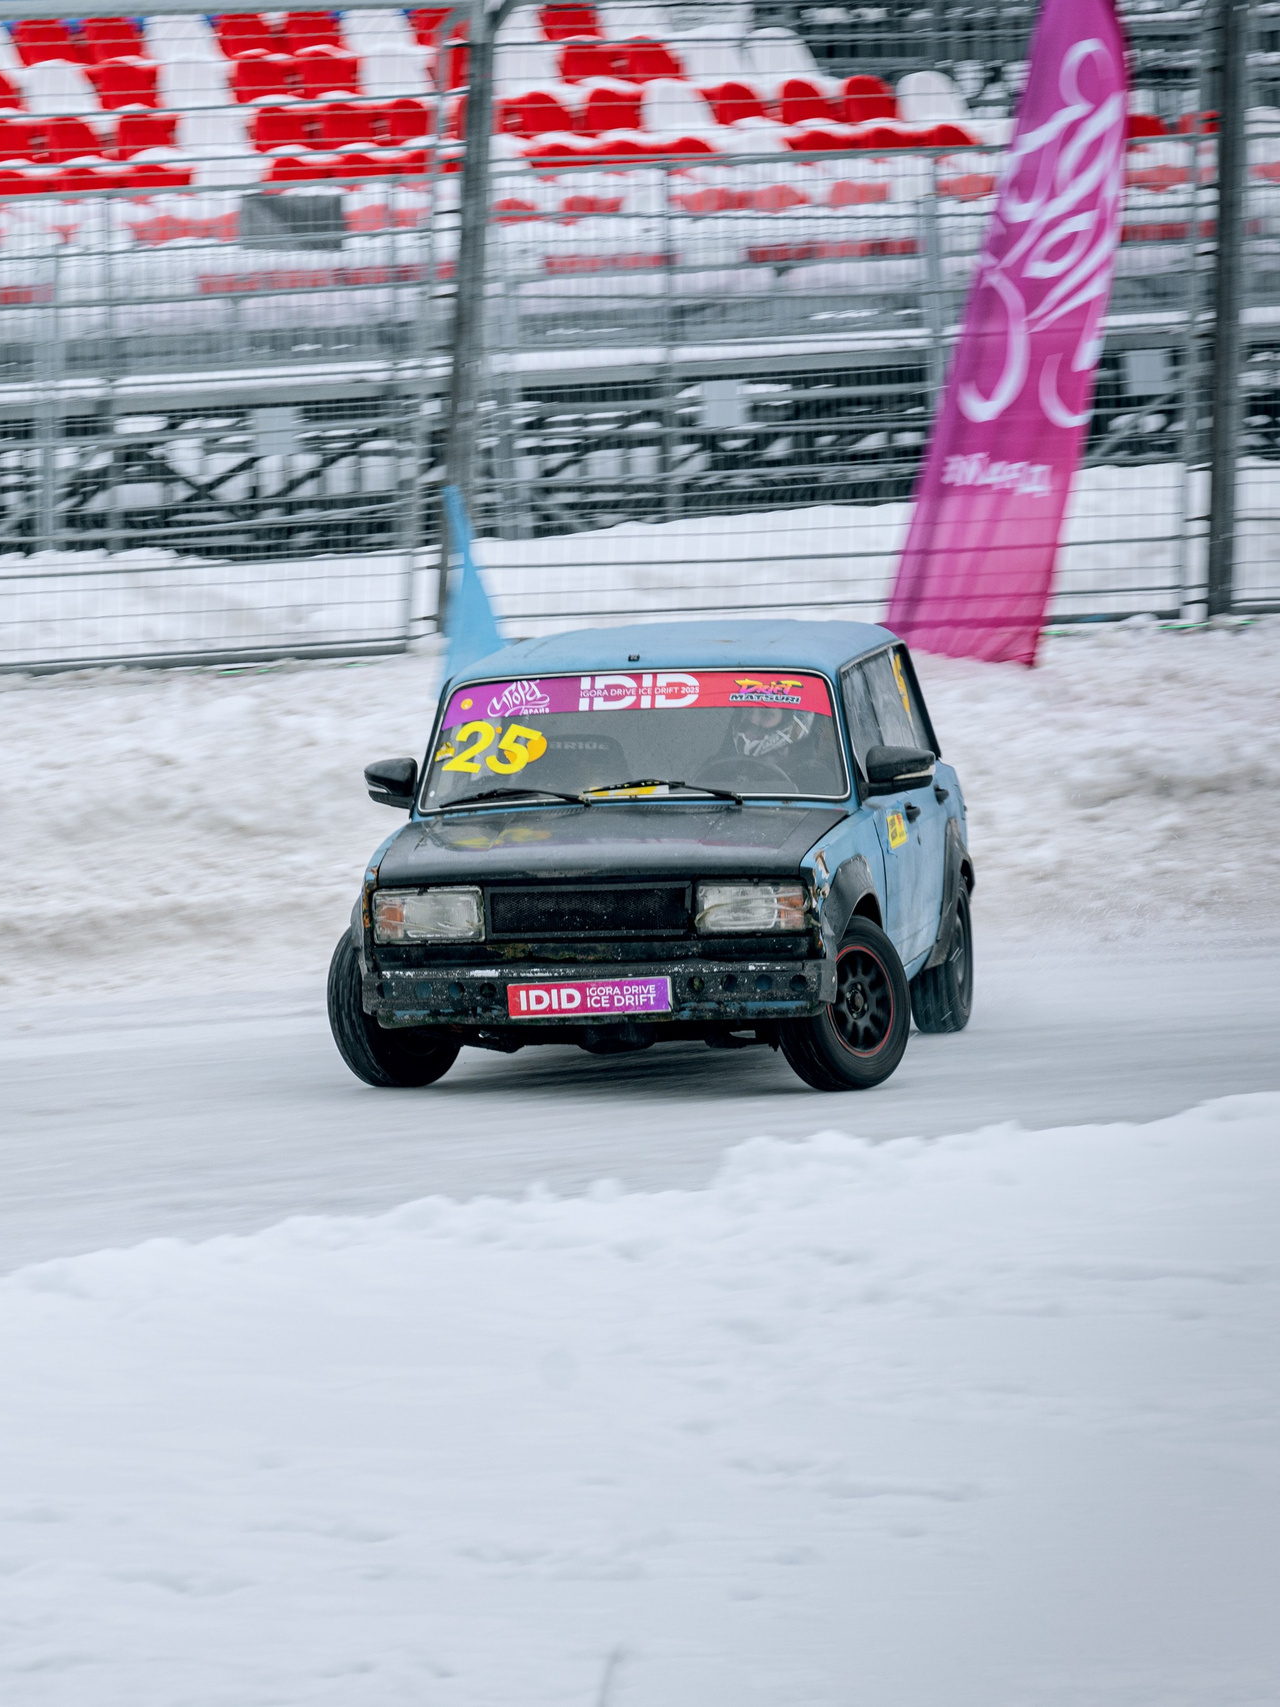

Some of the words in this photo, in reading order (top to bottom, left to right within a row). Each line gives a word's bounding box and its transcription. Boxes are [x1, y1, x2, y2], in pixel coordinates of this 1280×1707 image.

[578, 673, 700, 712] IDID
[580, 689, 609, 698] IGORA
[610, 687, 636, 697] DRIVE
[638, 686, 652, 695] ICE
[654, 686, 679, 695] DRIFT
[441, 720, 543, 775] 25
[586, 986, 621, 996] IGORA
[623, 984, 656, 995] DRIVE
[519, 988, 582, 1011] IDID
[587, 995, 610, 1008] ICE
[614, 994, 656, 1006] DRIFT
